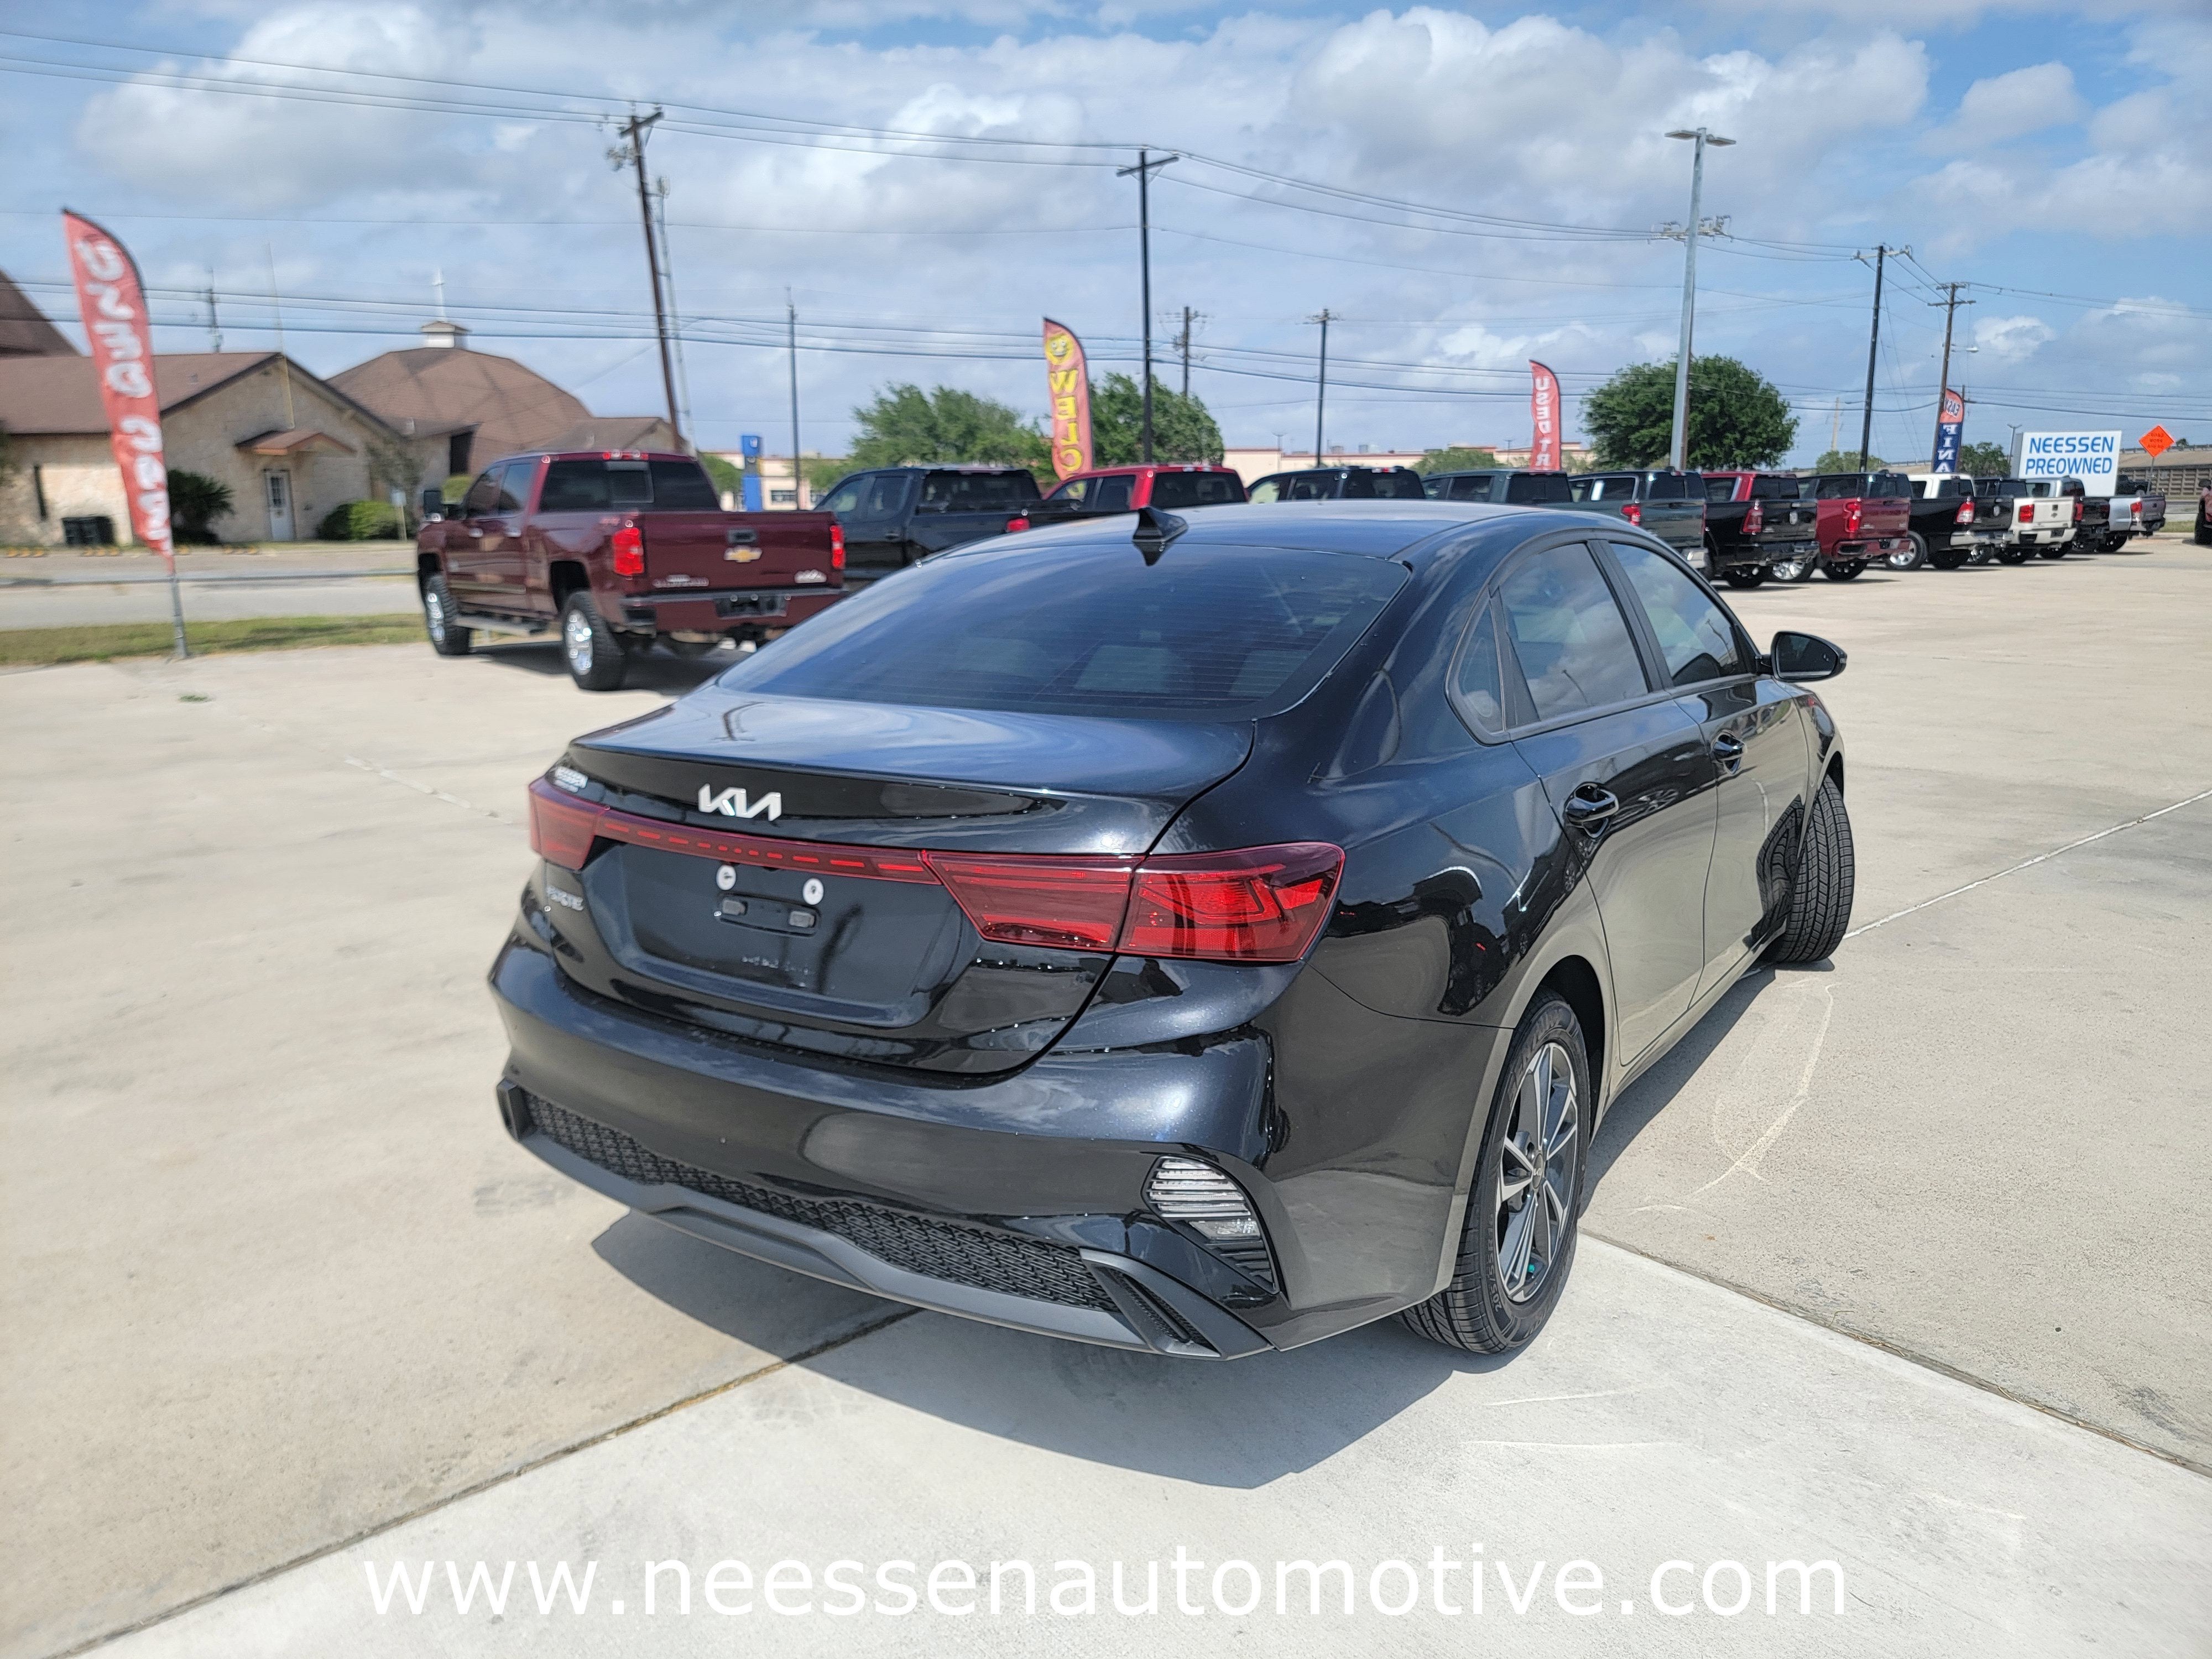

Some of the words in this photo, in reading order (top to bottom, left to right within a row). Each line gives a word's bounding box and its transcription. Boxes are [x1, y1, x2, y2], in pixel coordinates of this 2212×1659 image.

[2029, 436, 2114, 453] NEESSEN
[2025, 457, 2112, 474] PREOWNED
[698, 783, 782, 822] KIA
